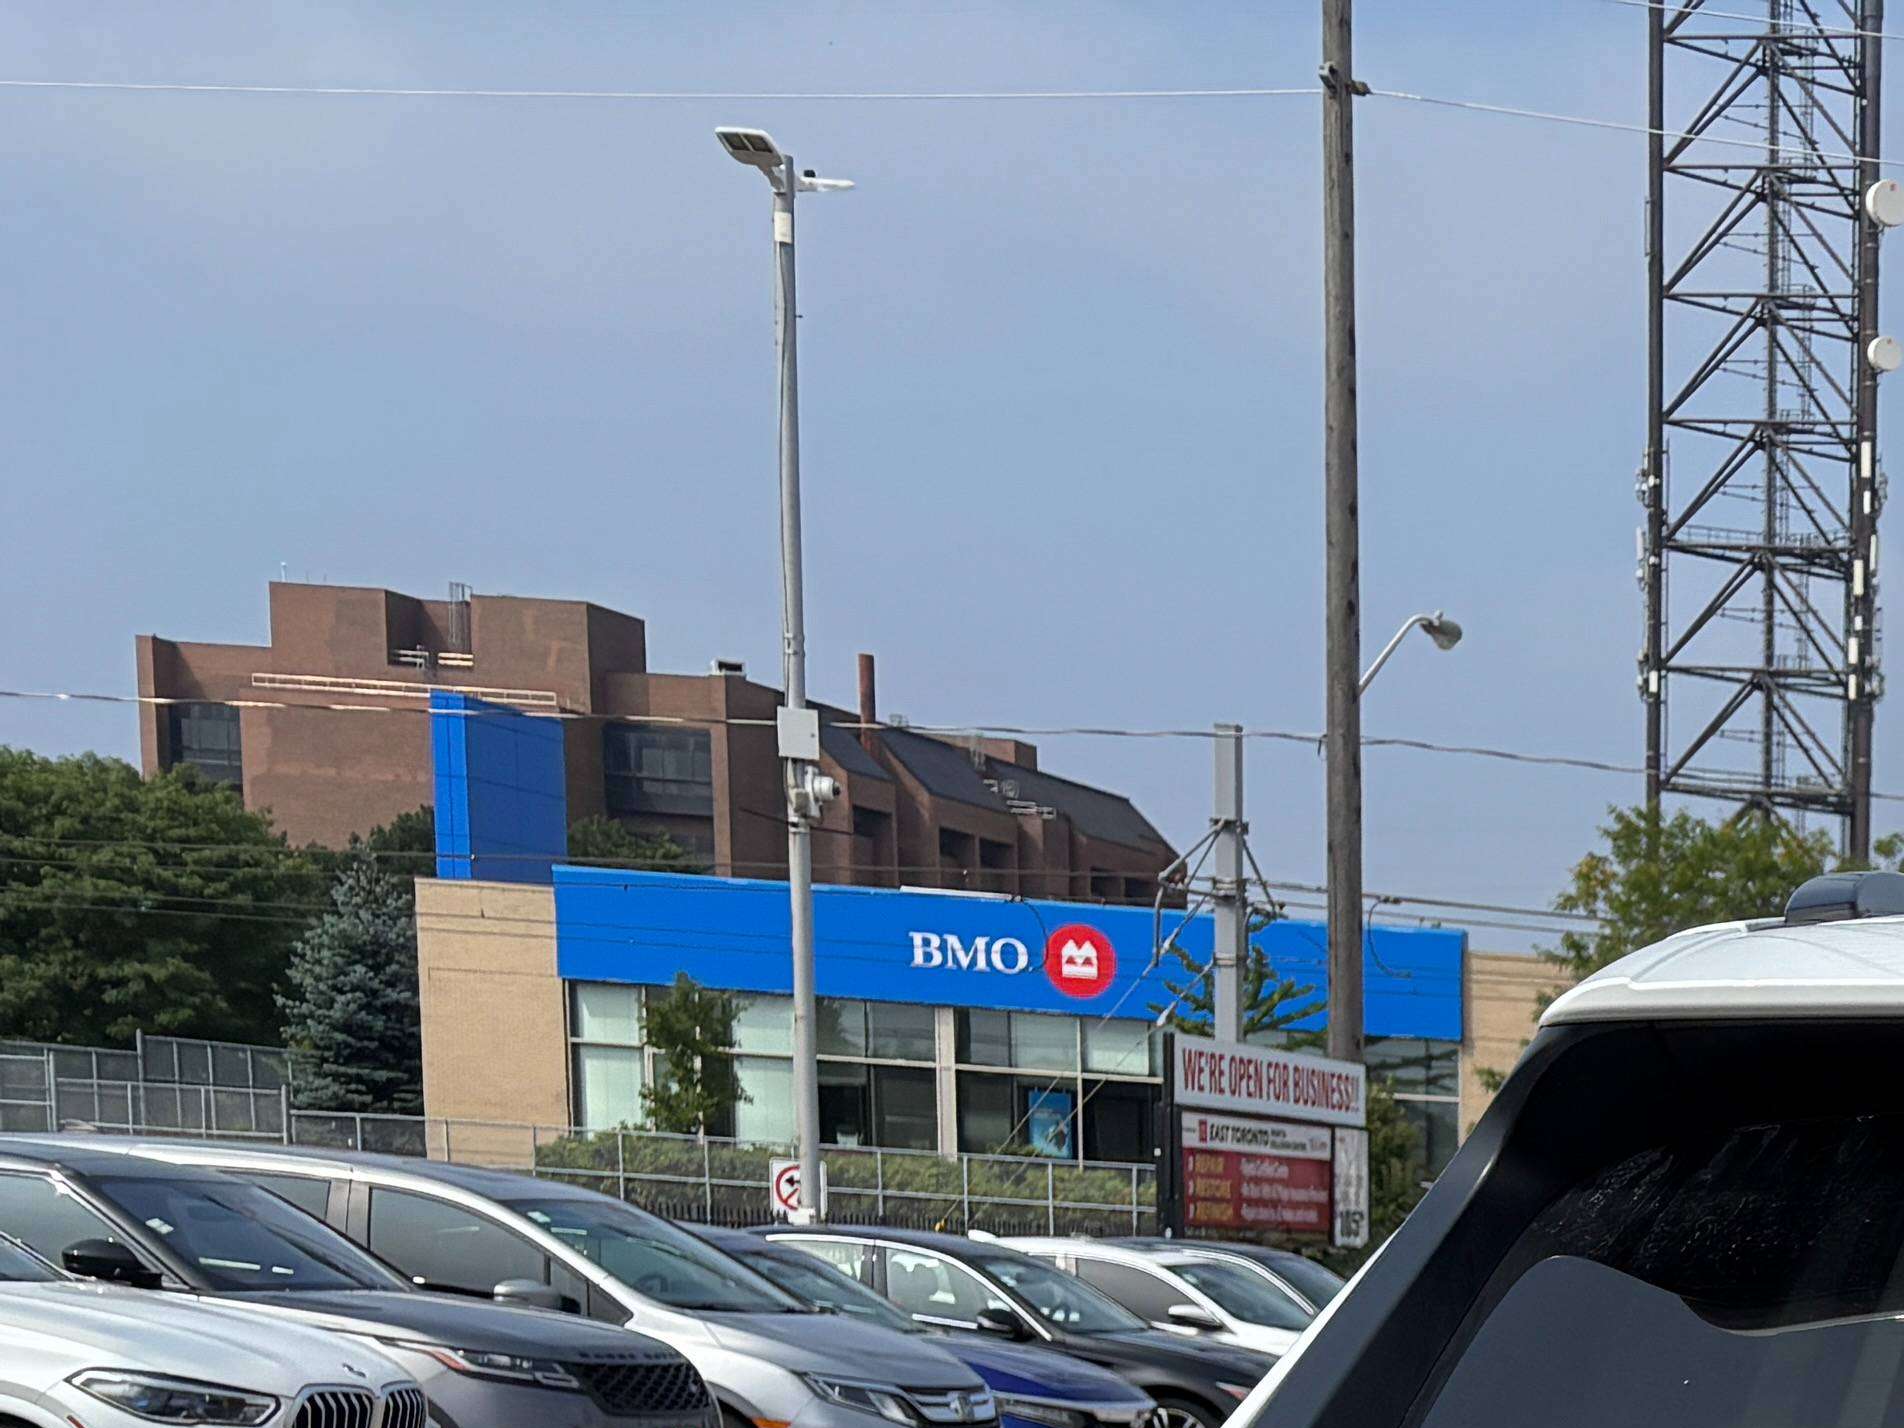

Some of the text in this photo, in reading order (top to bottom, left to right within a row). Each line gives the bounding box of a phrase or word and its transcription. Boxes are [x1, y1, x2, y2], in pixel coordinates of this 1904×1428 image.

[909, 931, 1029, 975] BMO
[1183, 1047, 1226, 1095] WE'RE
[1229, 1055, 1264, 1100] OPEN
[1267, 1061, 1290, 1104] FOR
